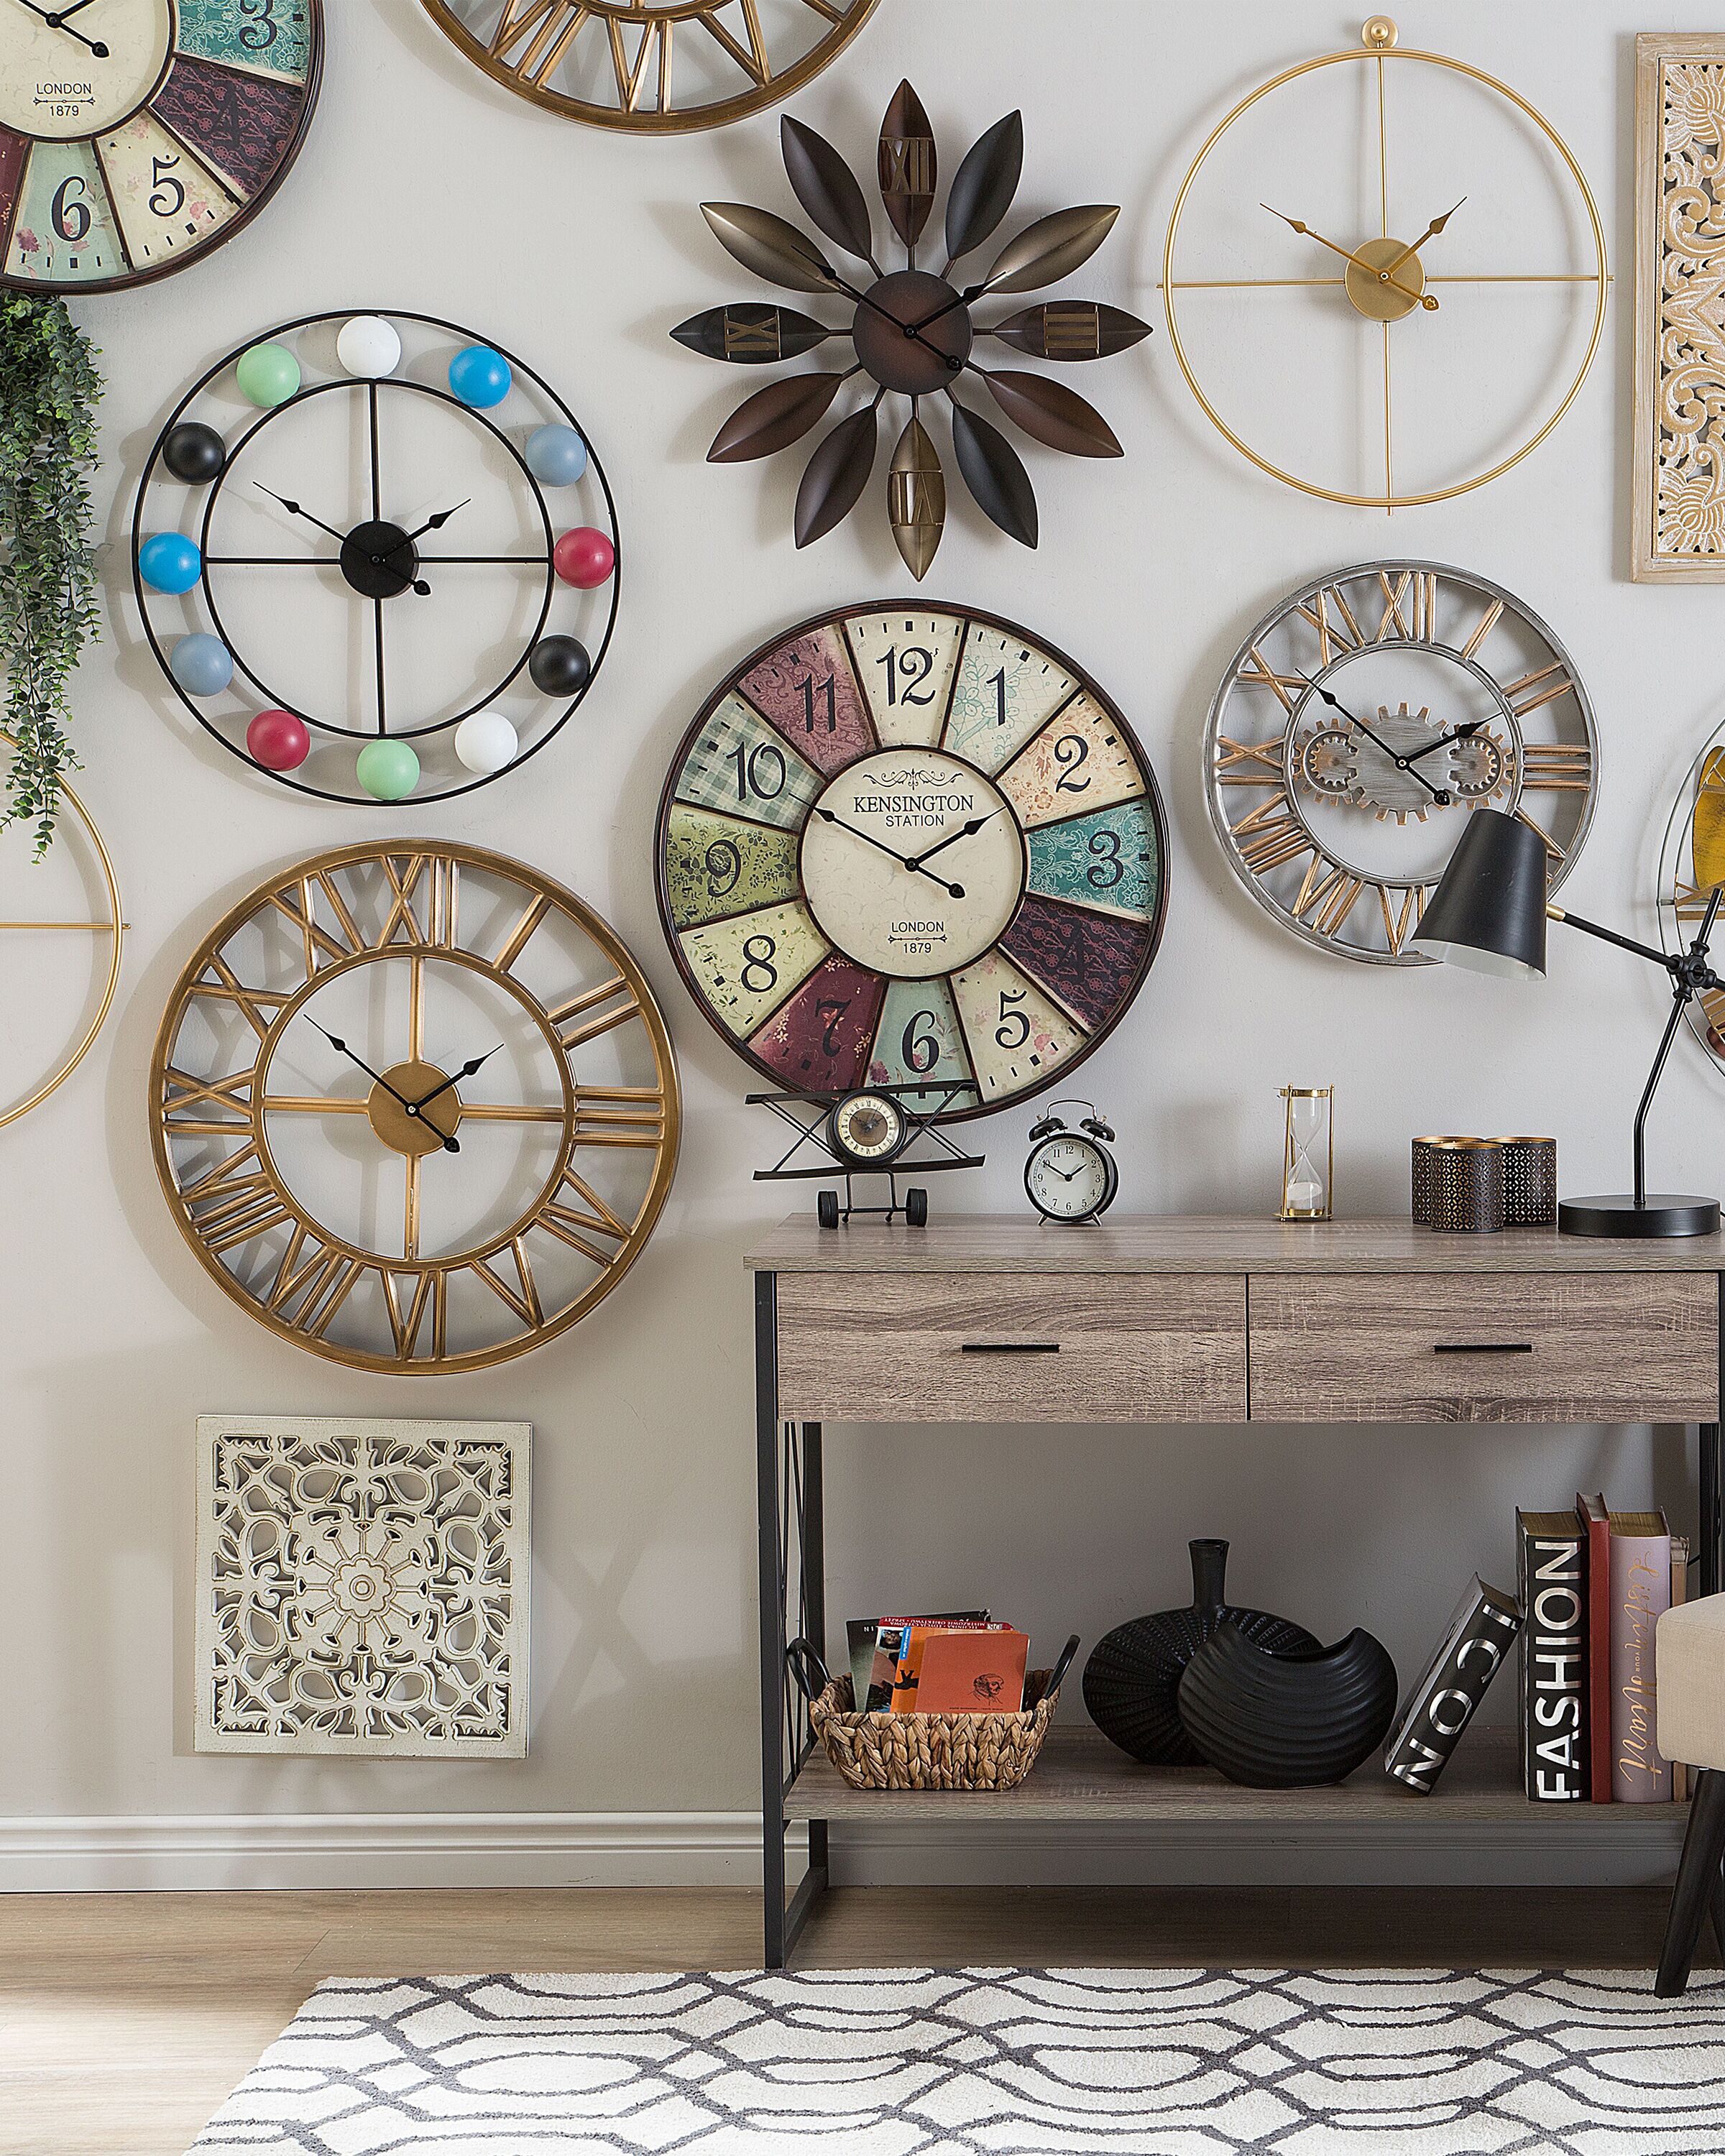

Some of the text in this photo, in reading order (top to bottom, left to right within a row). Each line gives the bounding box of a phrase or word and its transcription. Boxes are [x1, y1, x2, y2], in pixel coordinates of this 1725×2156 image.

[36, 83, 92, 95] LONDON
[49, 106, 79, 116] 1879
[149, 155, 185, 216] 5
[882, 137, 935, 195] XII
[51, 176, 91, 241] 6
[1043, 303, 1100, 359] III
[1375, 570, 1437, 644] XII
[794, 673, 836, 734] 11
[876, 646, 937, 707] 12
[986, 667, 1006, 727] 1
[725, 740, 786, 801] 10
[1054, 734, 1092, 793] 2
[853, 795, 974, 814] KENSINGTON
[885, 814, 945, 827] STATION
[705, 839, 742, 898] 9
[1086, 831, 1123, 889] 3
[380, 854, 459, 949] XII
[891, 921, 944, 933] LONDON
[741, 934, 778, 993] 8
[902, 942, 932, 954] 1879
[815, 998, 853, 1057] 7
[901, 1010, 940, 1074] 6
[994, 989, 1030, 1049] 5
[1037, 1174, 1043, 1182] 9
[1053, 1149, 1060, 1158] 11
[1066, 1146, 1074, 1154] 12
[1095, 1174, 1100, 1183] 3
[1041, 1188, 1047, 1197] 8
[1052, 1198, 1058, 1207] 7
[1066, 1202, 1072, 1210] 6
[1082, 1199, 1087, 1207] 5
[1090, 1189, 1096, 1197] 4
[1624, 1550, 1660, 1649] Listen
[1392, 1603, 1519, 1792] ICON
[1535, 1541, 1581, 1799] FASHION
[1619, 1675, 1662, 1789] Heart
